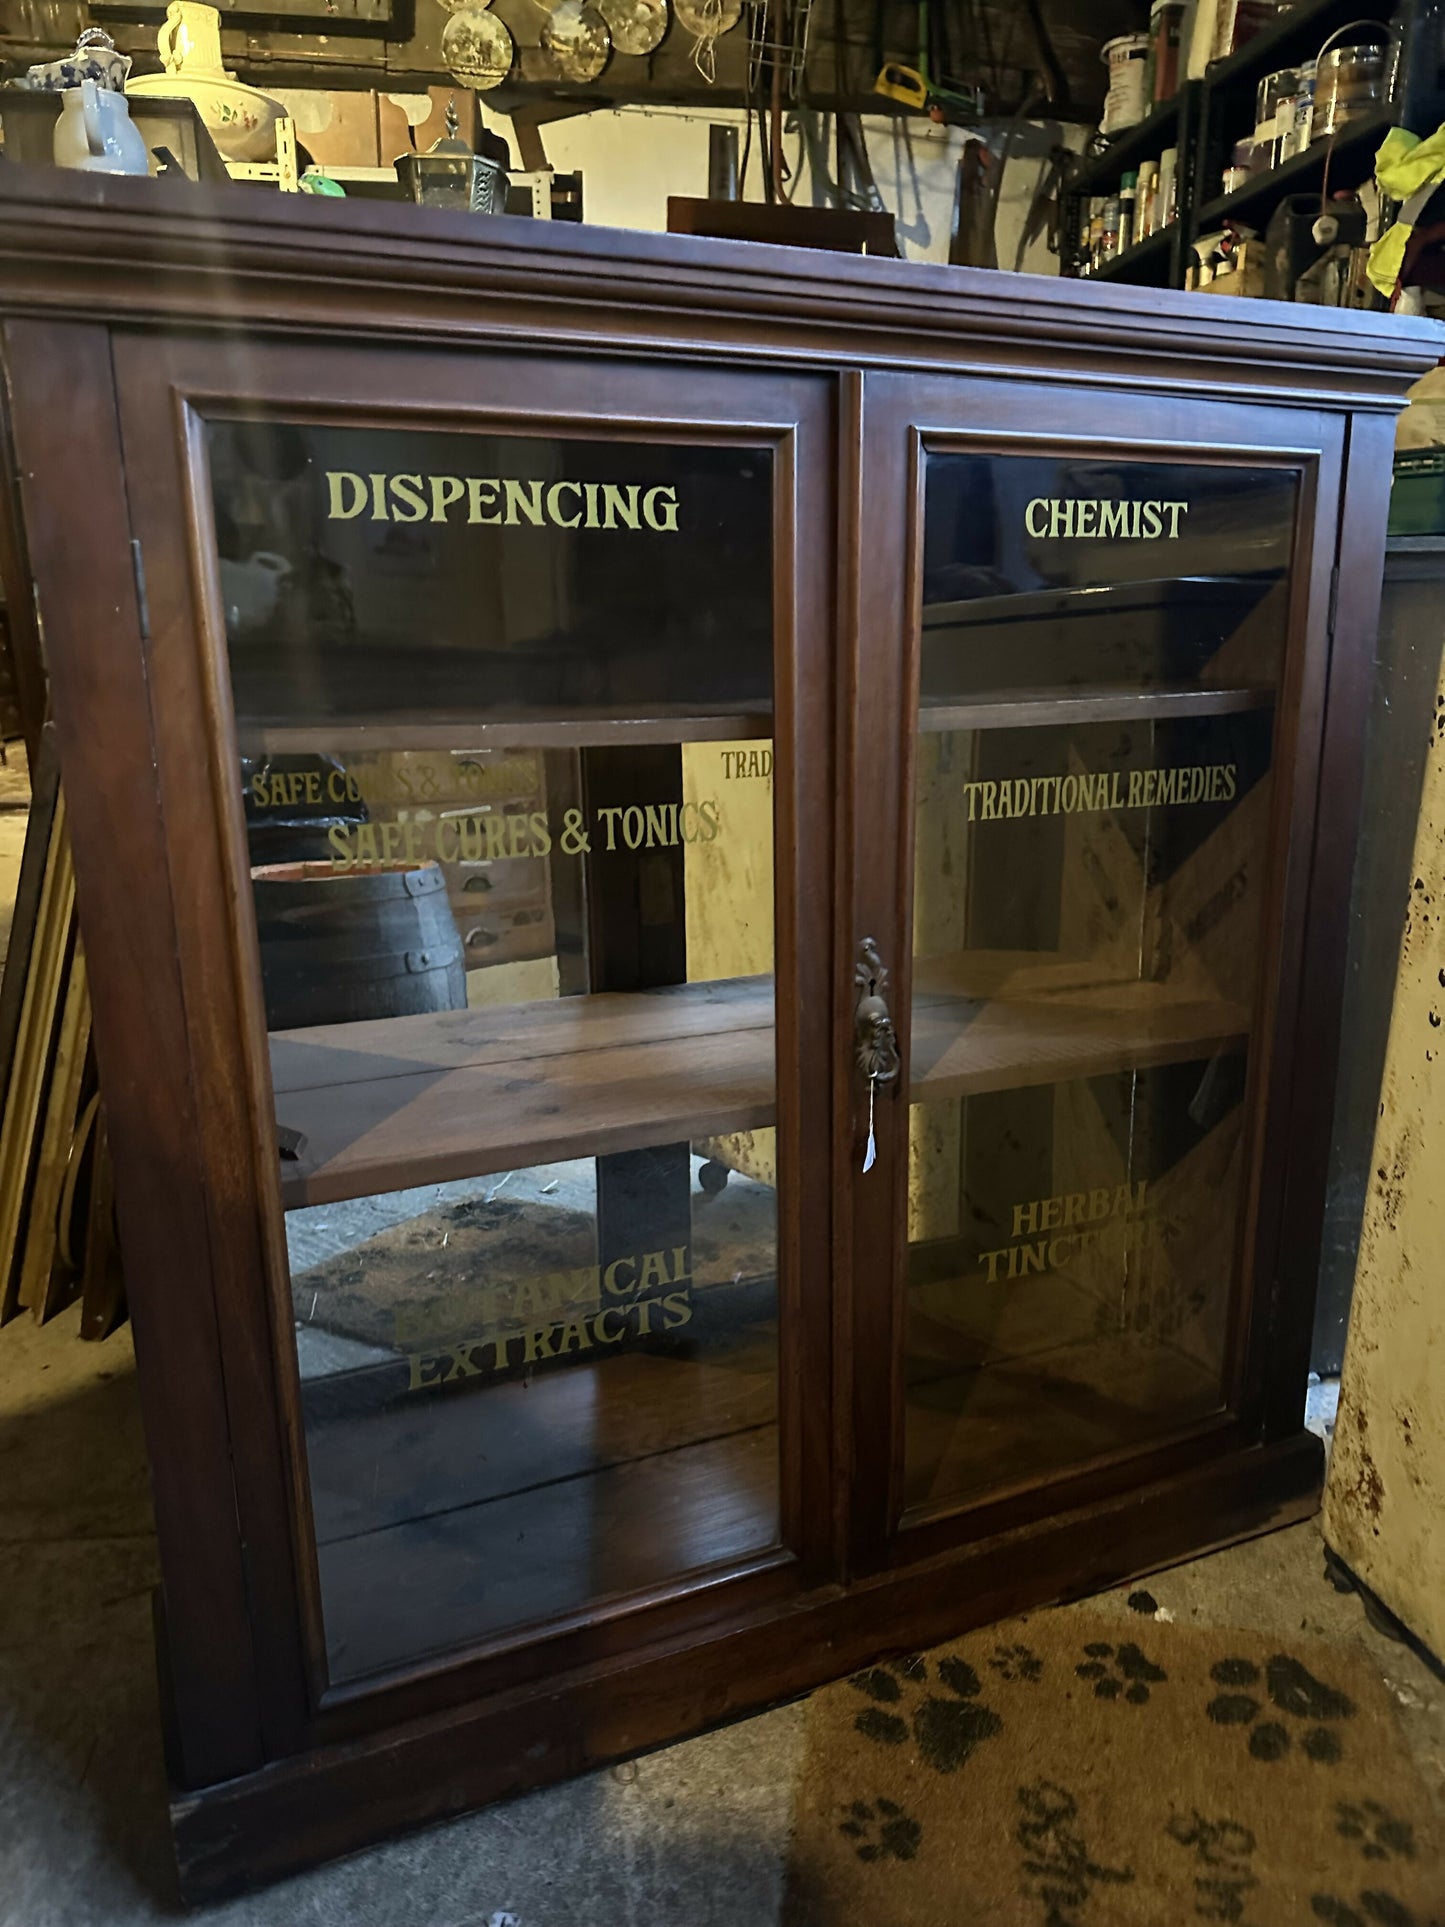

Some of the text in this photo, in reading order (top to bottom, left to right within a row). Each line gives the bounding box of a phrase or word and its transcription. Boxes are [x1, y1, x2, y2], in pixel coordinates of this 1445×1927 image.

[325, 471, 680, 532] DISPENCING
[1025, 498, 1188, 539] CHEMIST
[251, 770, 322, 807] SAFE
[328, 765, 414, 804] CUS
[964, 764, 1236, 821] TRADITIONAL REMEDIES
[327, 799, 720, 872] SAFE CURES & TONICS
[408, 1289, 693, 1391] EXTRACTS
